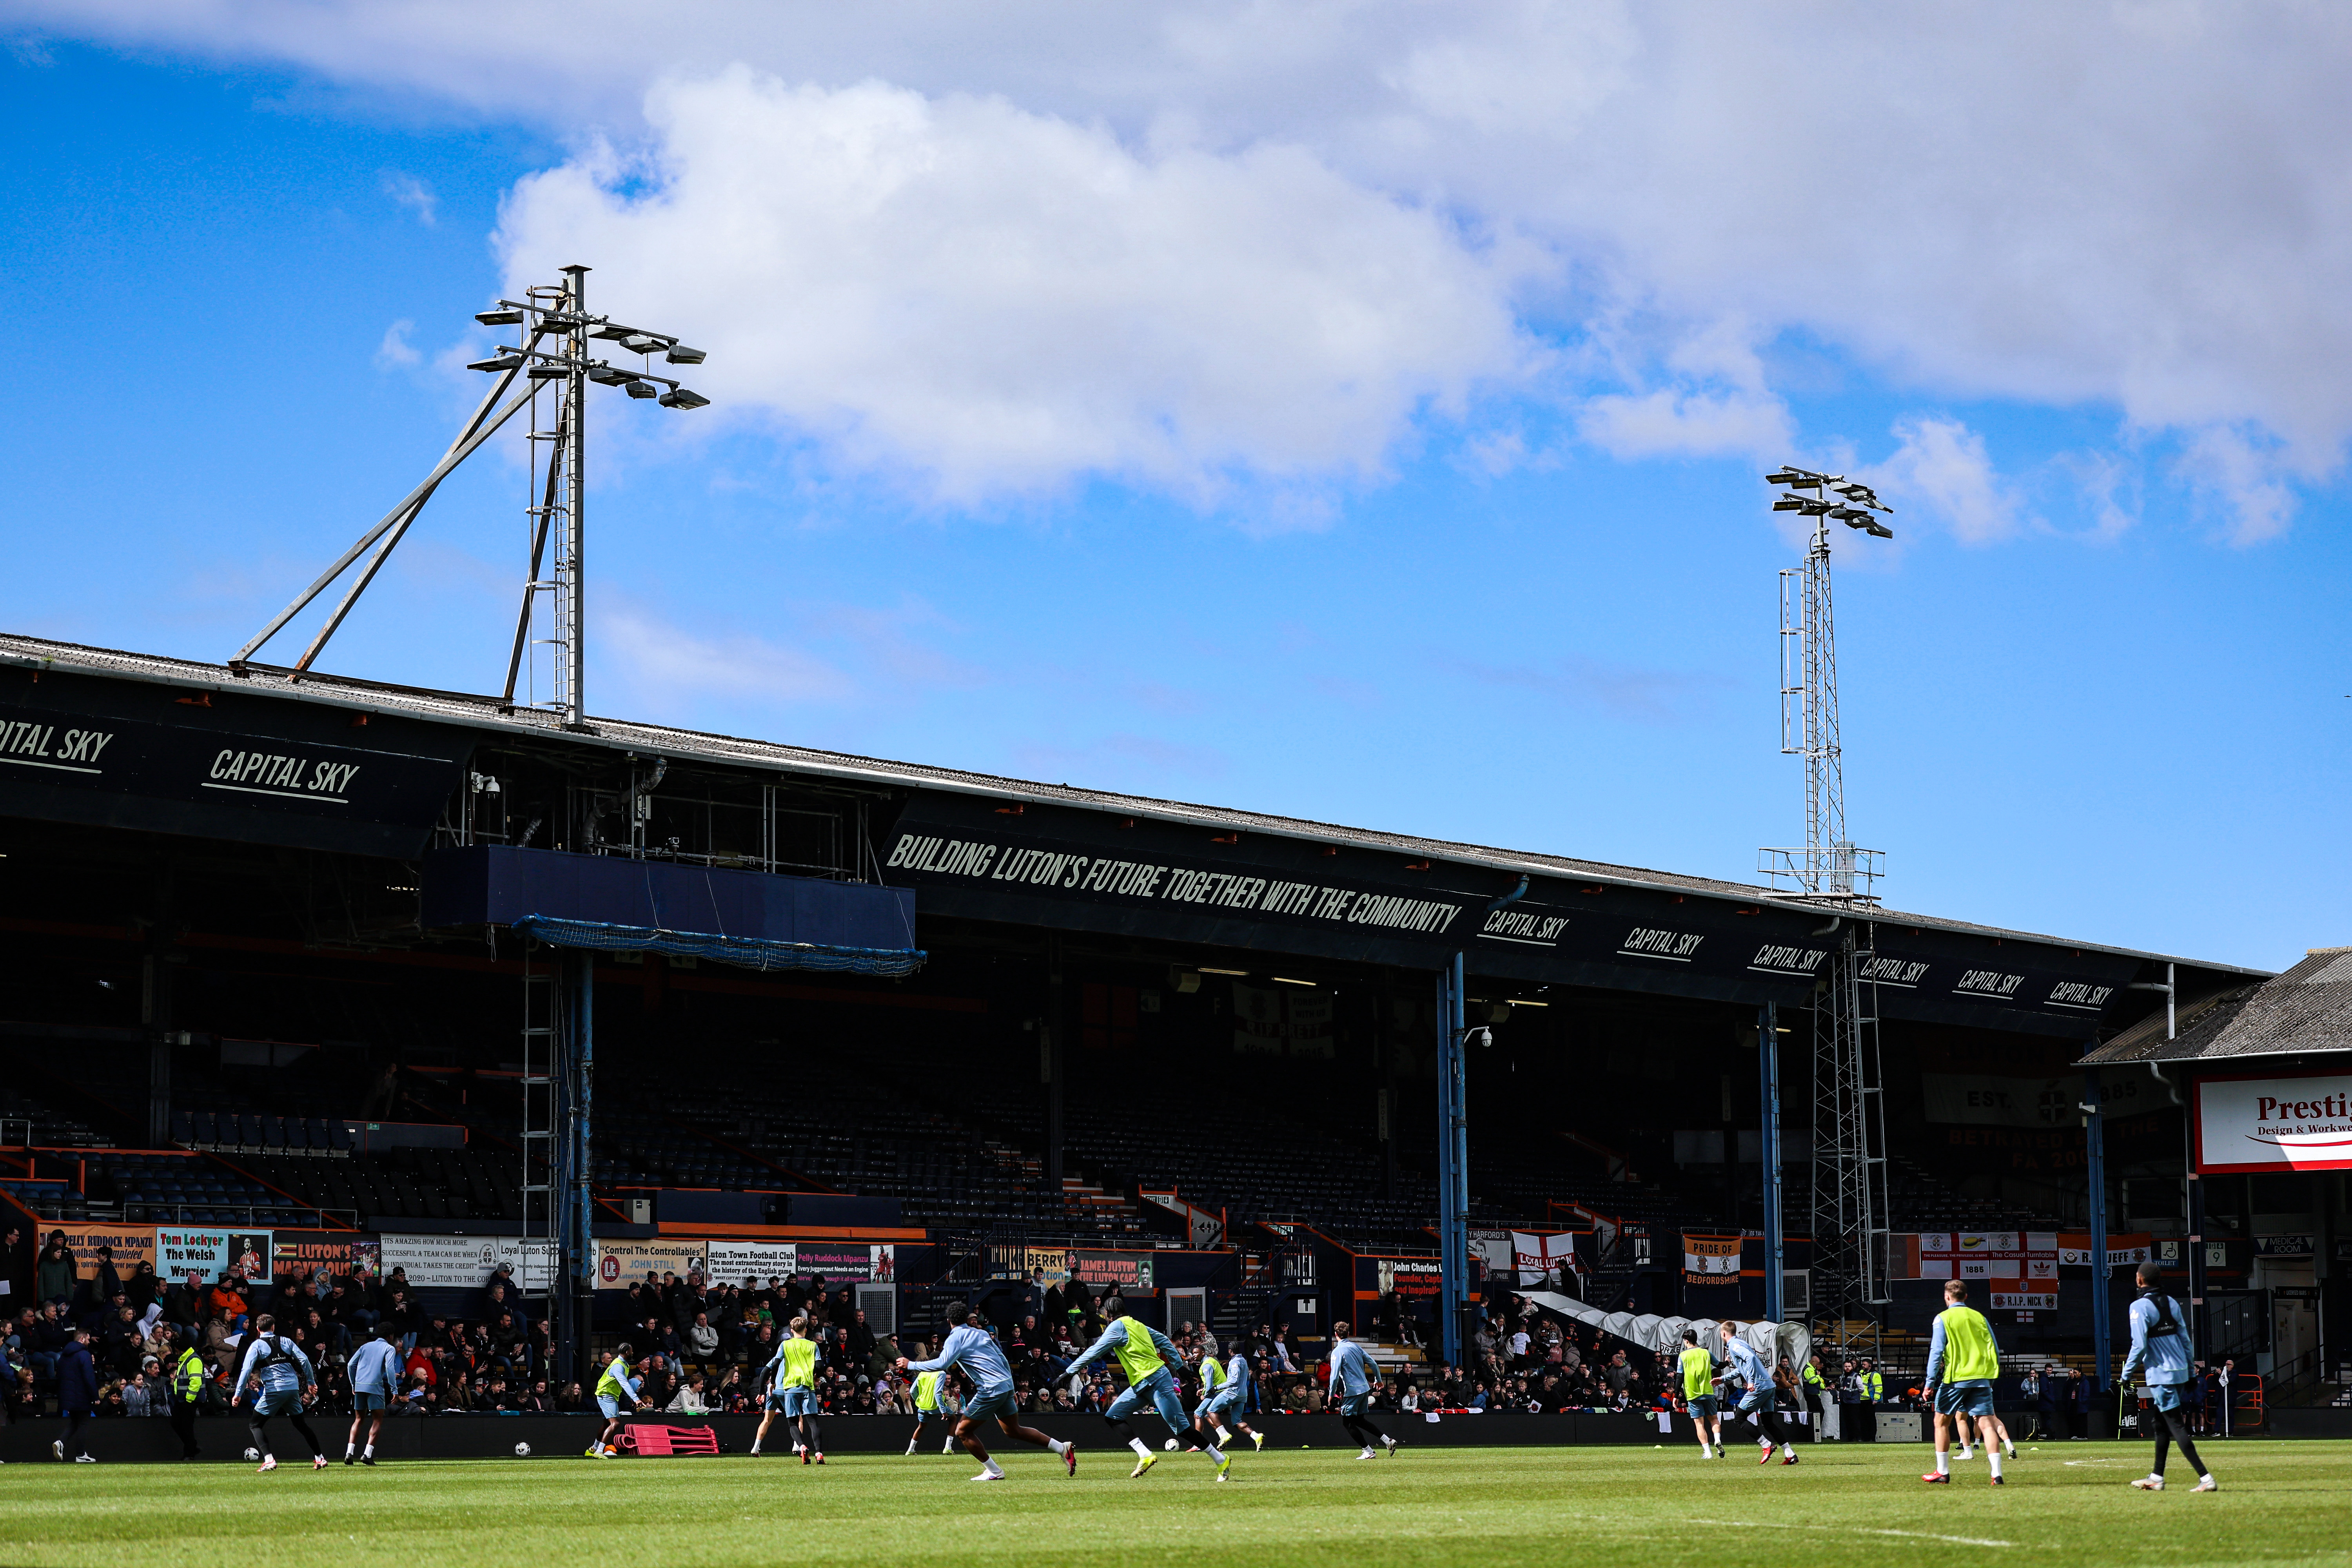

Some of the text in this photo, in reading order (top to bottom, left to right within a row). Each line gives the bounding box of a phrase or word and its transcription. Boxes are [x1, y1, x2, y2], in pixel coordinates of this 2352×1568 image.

[57, 730, 113, 762] SKY
[211, 750, 360, 793] CAPITAL SKY
[887, 835, 1462, 933] BUILDING LUTON'S FUTURE TOGETHER WITH THE COMMUNITY
[1484, 910, 1569, 938] CAPITAL SKY
[1625, 928, 1704, 955] CAPITAL SKY
[1754, 945, 1827, 970] CAPITAL SKY
[1861, 958, 1929, 982] CAPITAL SKY
[1958, 970, 2024, 993] CAPITAL SKY
[2050, 982, 2113, 1004] CAPITAL SKY
[1294, 996, 1328, 1005] FOREVER
[1295, 1009, 1326, 1018] WITH US
[1279, 1023, 1321, 1038] BRETT
[1967, 1081, 2138, 1109] EST. 885
[2256, 1092, 2352, 1122] Presti
[1948, 1116, 2160, 1149] BETRAYED THE
[2258, 1125, 2304, 1136] Design &
[2012, 1152, 2039, 1169] FA
[160, 1233, 224, 1248] Tom Lockyer
[1473, 1230, 1505, 1239] HARFORD'S
[2270, 1237, 2303, 1245] MEDICAL
[65, 1235, 153, 1248] PELLY RUDDOCK MPANZU
[165, 1248, 216, 1261] The Welsh
[298, 1243, 351, 1259] LUTON'S
[501, 1245, 519, 1256] Loyal
[635, 1246, 649, 1254] The
[750, 1251, 777, 1259] Football
[779, 1251, 795, 1259] Club
[1693, 1243, 1732, 1254] PRIDE OF
[2274, 1245, 2301, 1253] ROOM
[798, 1254, 868, 1265] Pelly Ruddock Mpanzu
[1028, 1254, 1064, 1267] BERRY
[1520, 1254, 1572, 1268] LOYAL LUTN
[2107, 1252, 2129, 1263] JEFF
[2213, 1252, 2220, 1262] 9
[629, 1259, 675, 1269] JOHN STILL
[1080, 1259, 1136, 1272] JAMES JUSTIN
[1394, 1262, 1410, 1271] John
[1411, 1263, 1437, 1272] Charles
[170, 1265, 211, 1278] Warrior
[1079, 1272, 1139, 1283] THE LUTON CAFU
[1394, 1273, 1443, 1285] Founder, Capta
[1687, 1274, 1739, 1285] BEDFORDSHIRE
[1394, 1285, 1441, 1296] and Inspiratio
[2007, 1296, 2025, 1306] R.I.P.
[2027, 1296, 2042, 1306] NICK
